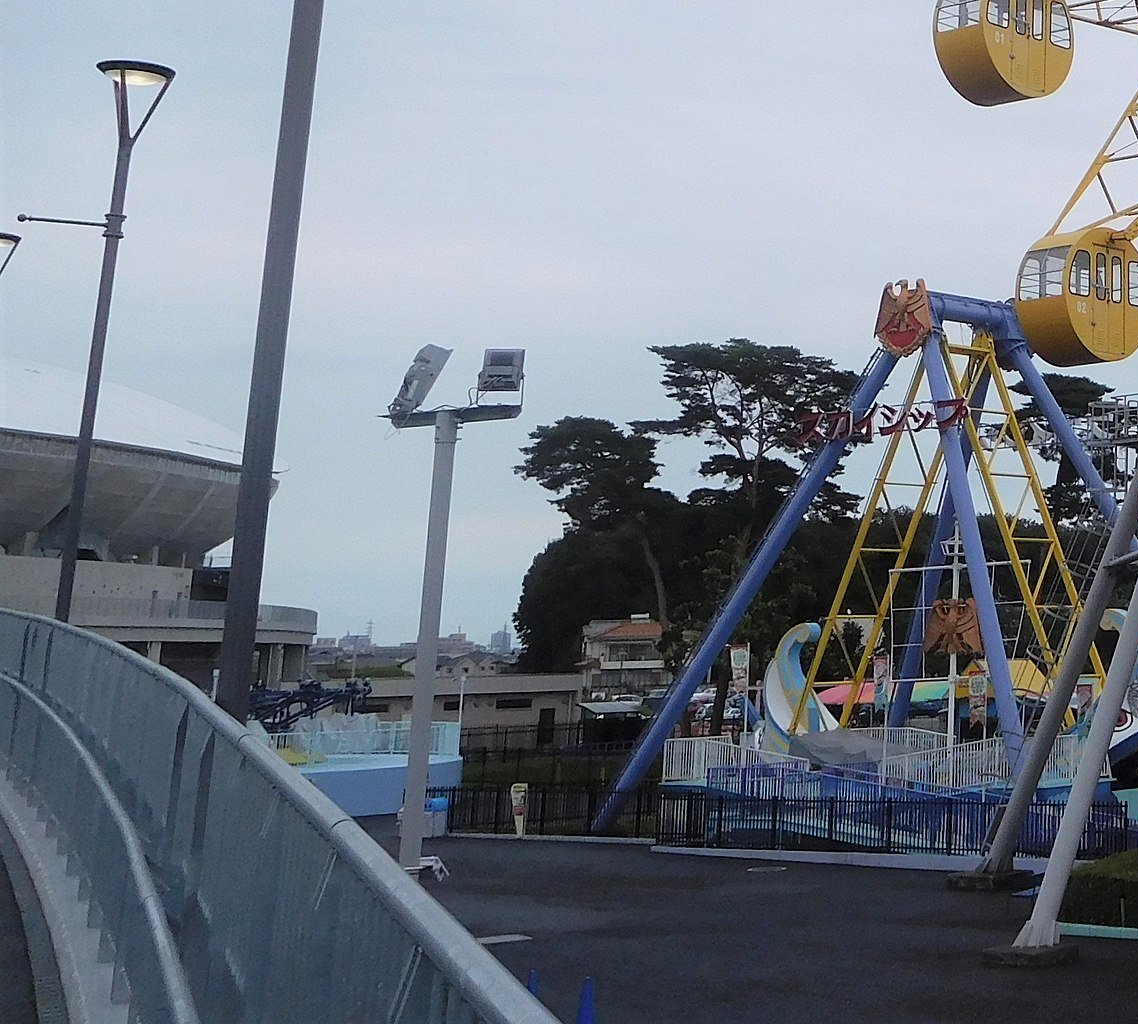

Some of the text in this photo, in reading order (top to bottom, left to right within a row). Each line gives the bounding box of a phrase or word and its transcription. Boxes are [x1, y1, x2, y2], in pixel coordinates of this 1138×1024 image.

[1076, 301, 1088, 314] 02
[795, 397, 971, 444] スカイシップ
